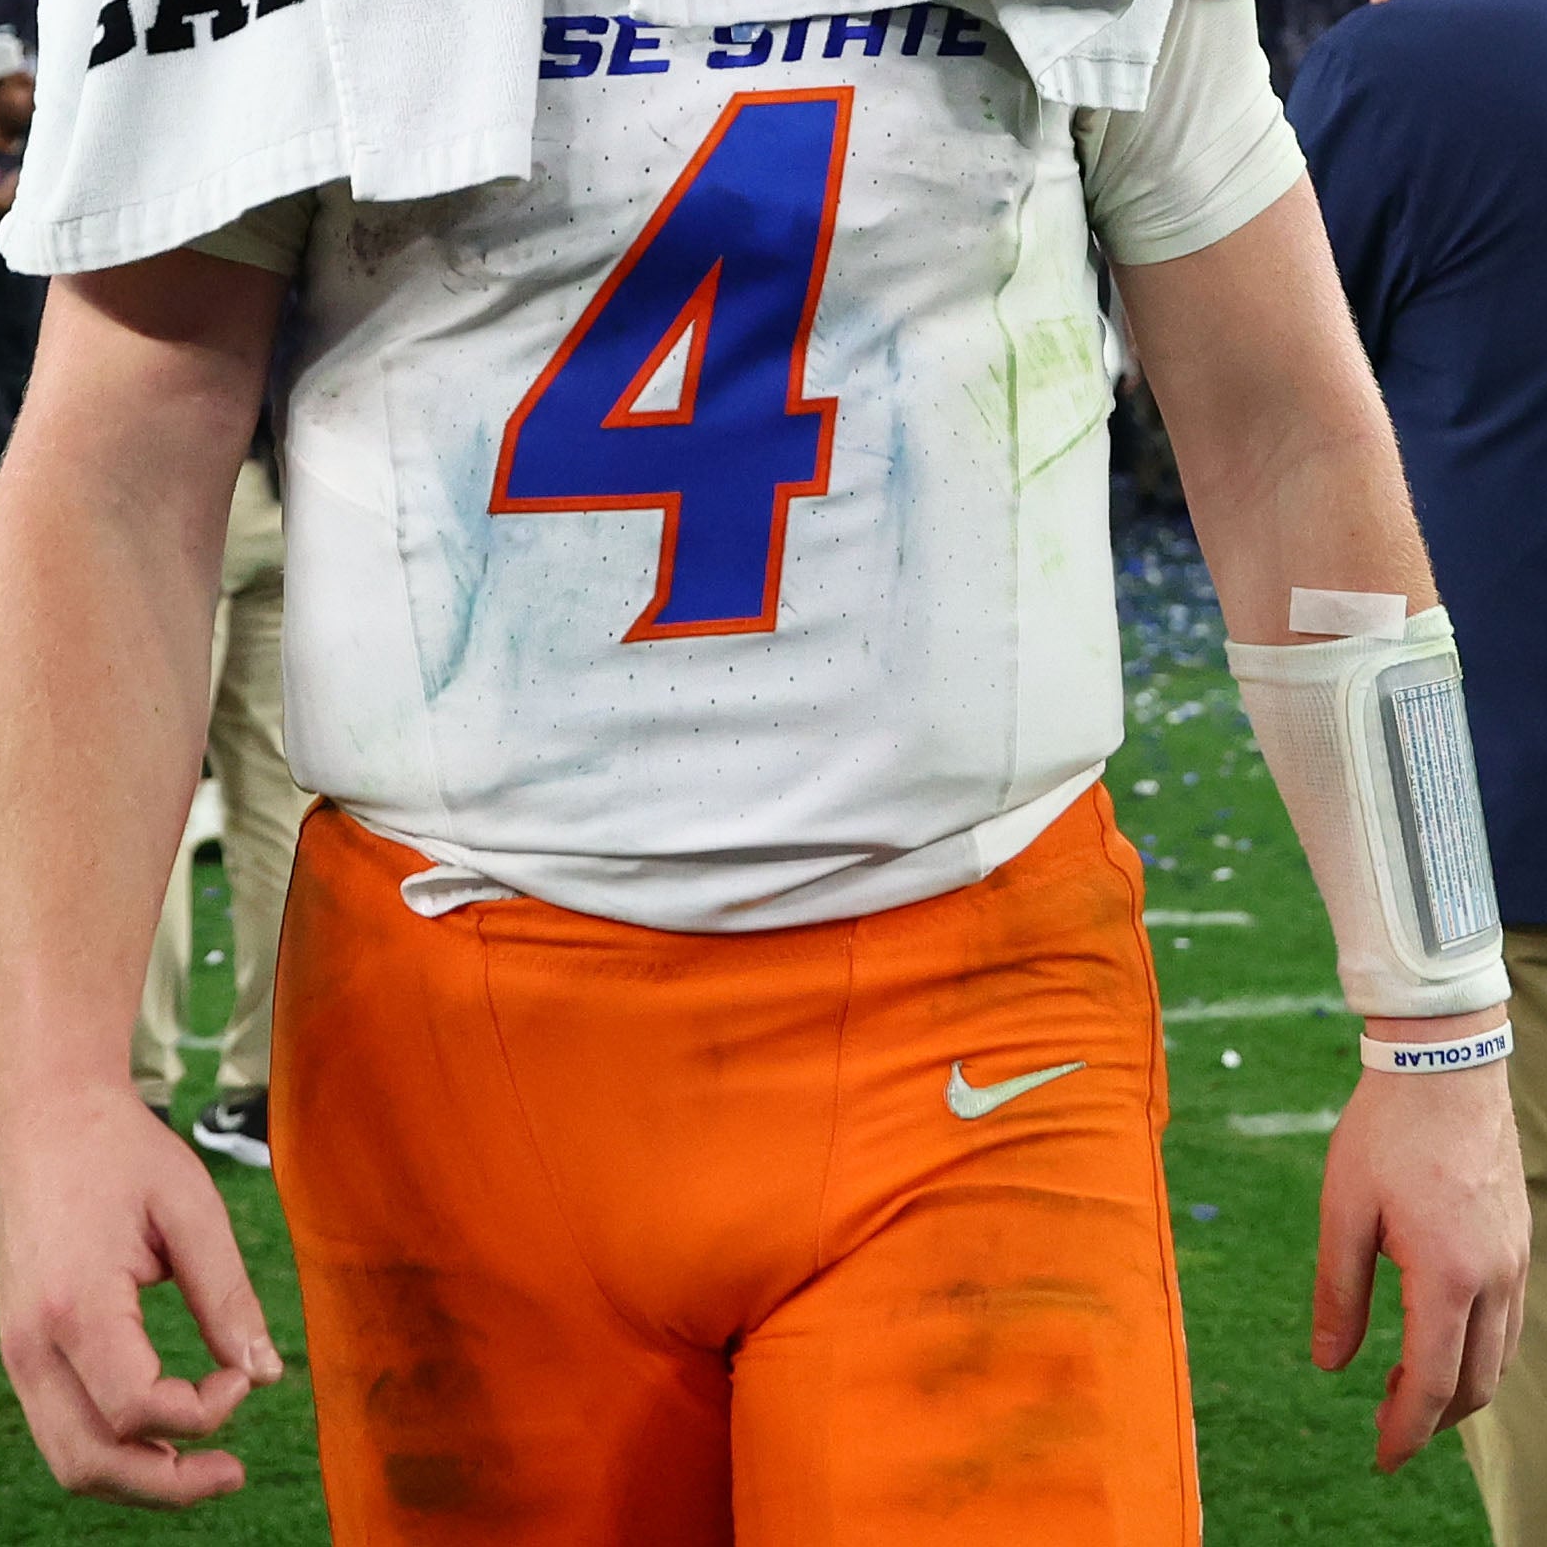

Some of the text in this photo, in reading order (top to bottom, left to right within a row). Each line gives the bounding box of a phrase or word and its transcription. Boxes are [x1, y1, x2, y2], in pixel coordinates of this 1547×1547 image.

[488, 84, 855, 644] 4
[1394, 1034, 1506, 1068] BLUE COLLAR
